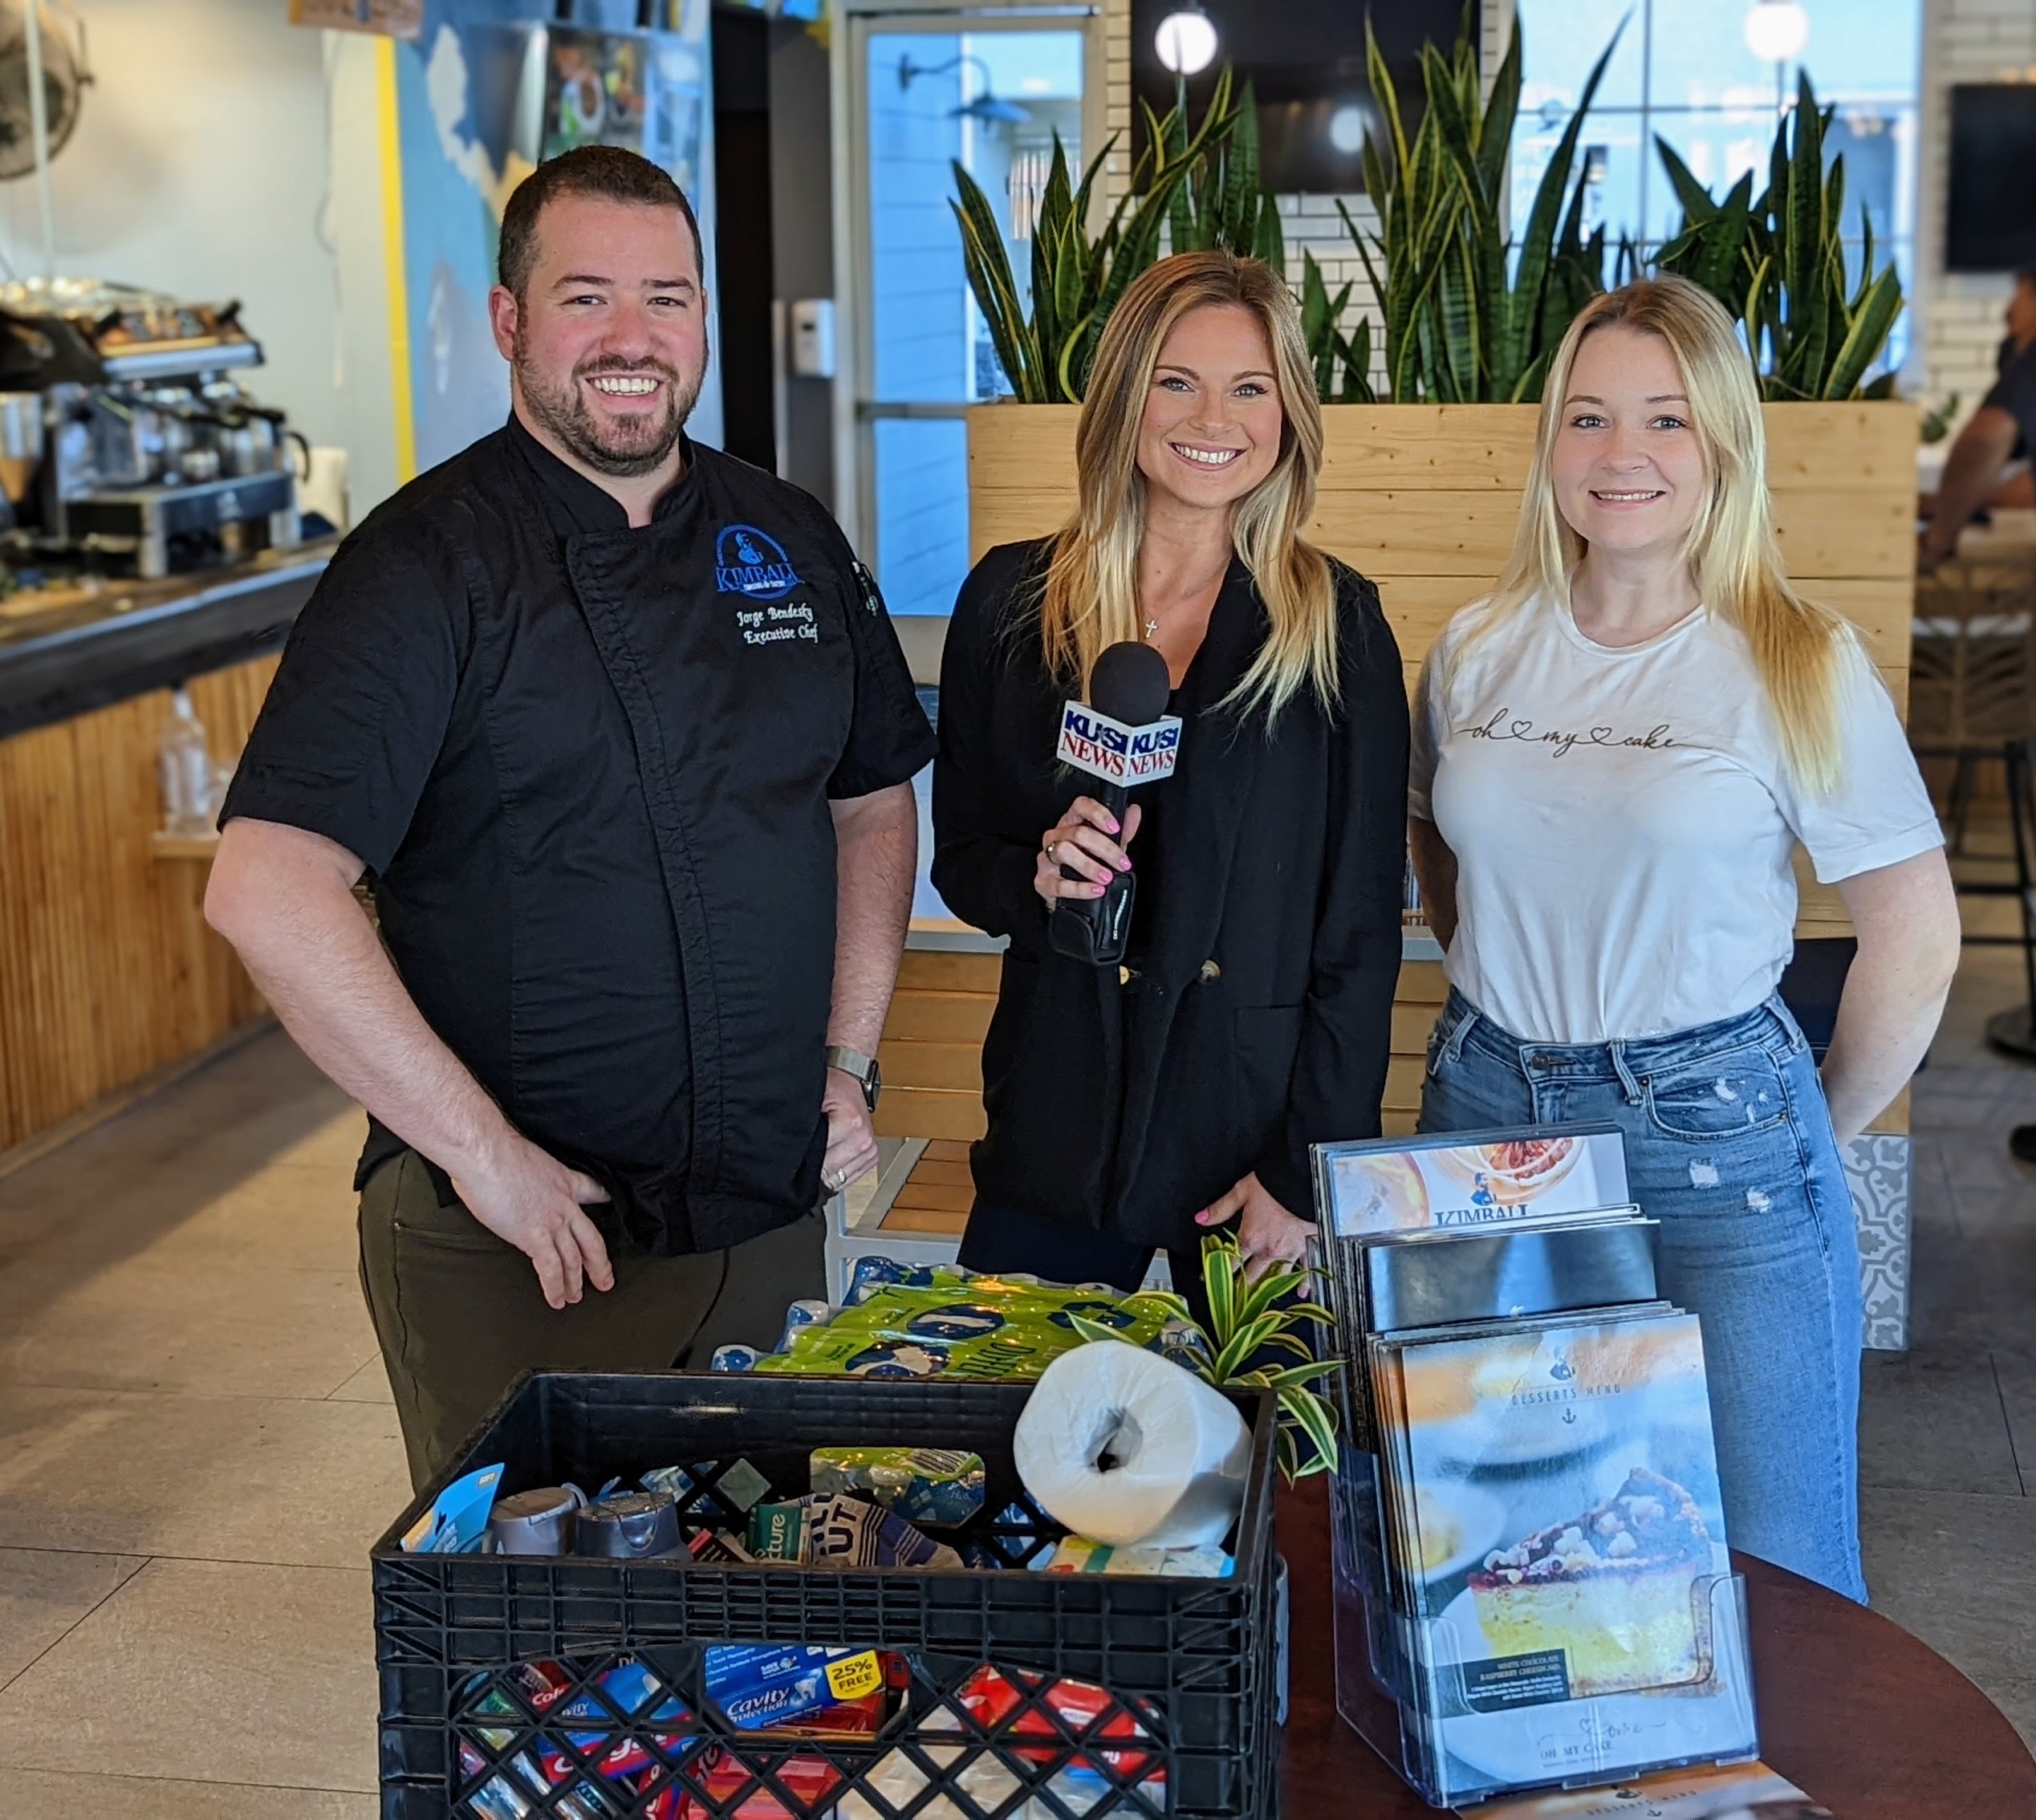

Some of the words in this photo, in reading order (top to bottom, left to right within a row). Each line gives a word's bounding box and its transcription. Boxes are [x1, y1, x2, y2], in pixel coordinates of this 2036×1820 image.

[737, 611, 765, 628] Jorge
[743, 627, 796, 645] Executive
[798, 623, 818, 644] Chef
[1064, 709, 1129, 755] KUSI
[1131, 727, 1179, 755] KUSI
[1467, 708, 1509, 739] oh
[1542, 731, 1578, 758] my
[1623, 725, 1682, 750] cake
[1060, 731, 1126, 777] NEWS
[1126, 749, 1175, 778] NEWS
[831, 1658, 873, 1680] 25%
[839, 1672, 873, 1690] FREE
[726, 1687, 790, 1716] Cavity
[1540, 1749, 1557, 1759] OH
[1564, 1745, 1580, 1756] MY
